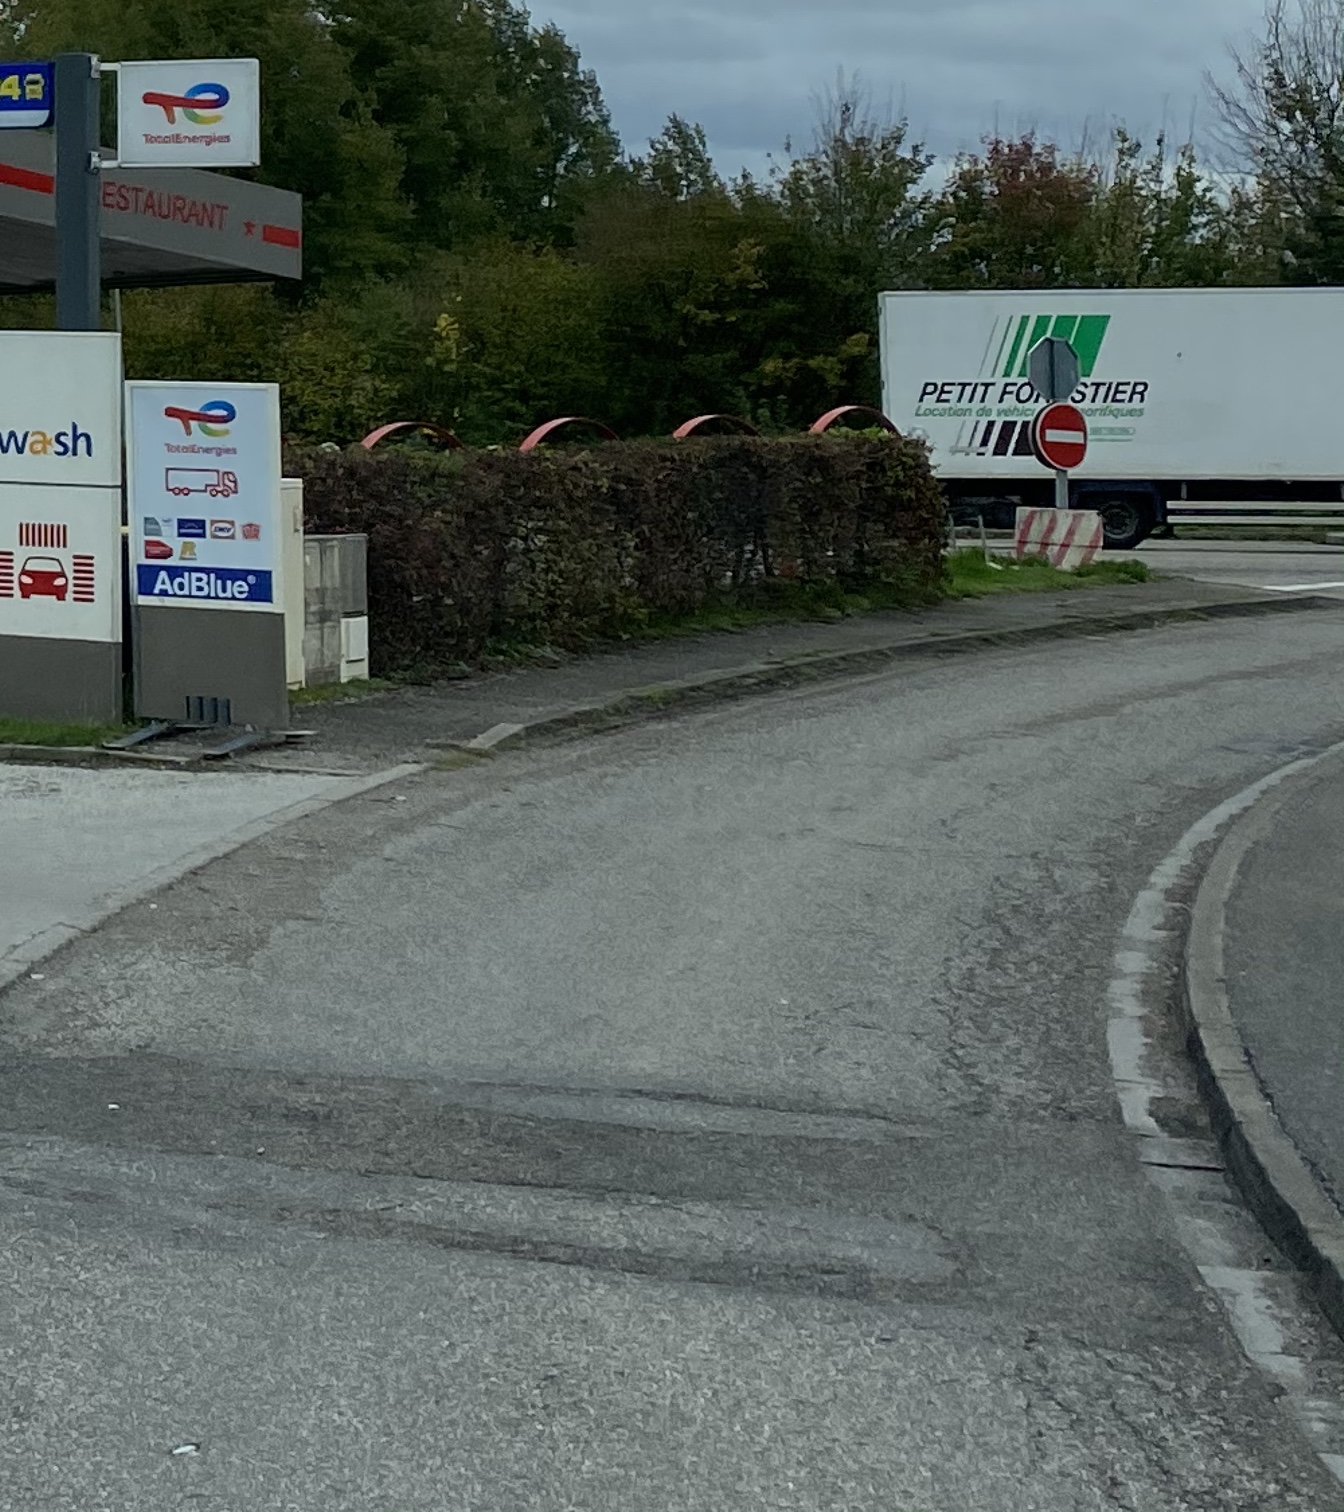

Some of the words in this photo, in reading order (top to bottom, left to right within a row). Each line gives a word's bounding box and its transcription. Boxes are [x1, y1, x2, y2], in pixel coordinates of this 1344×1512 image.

[143, 133, 231, 146] TotalEnergies
[102, 181, 228, 230] ESTAURANT
[918, 382, 996, 403] PETIT
[998, 381, 1149, 404] FOSTIER
[915, 405, 972, 417] Location
[976, 406, 992, 417] de
[164, 443, 237, 457] TotalEnergies
